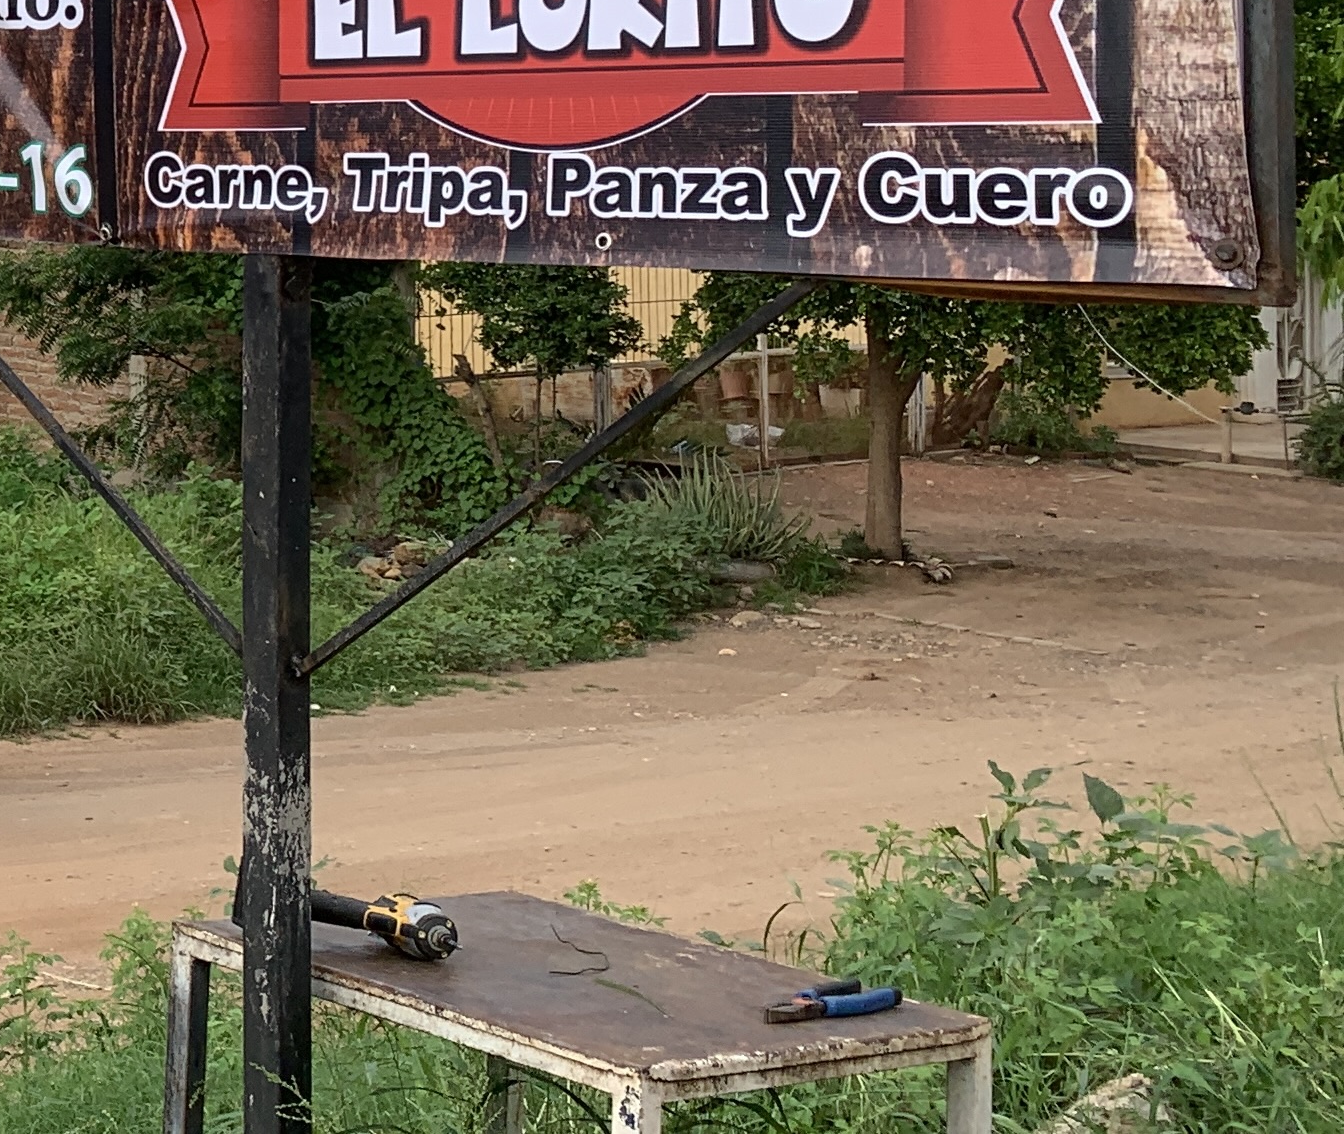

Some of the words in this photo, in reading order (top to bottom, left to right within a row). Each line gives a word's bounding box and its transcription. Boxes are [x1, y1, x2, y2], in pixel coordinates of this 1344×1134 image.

[146, 152, 326, 222] Carne,
[346, 154, 525, 228] Tripa,
[547, 153, 767, 219] Panza
[787, 168, 840, 237] y
[859, 153, 1132, 227] Cuero
